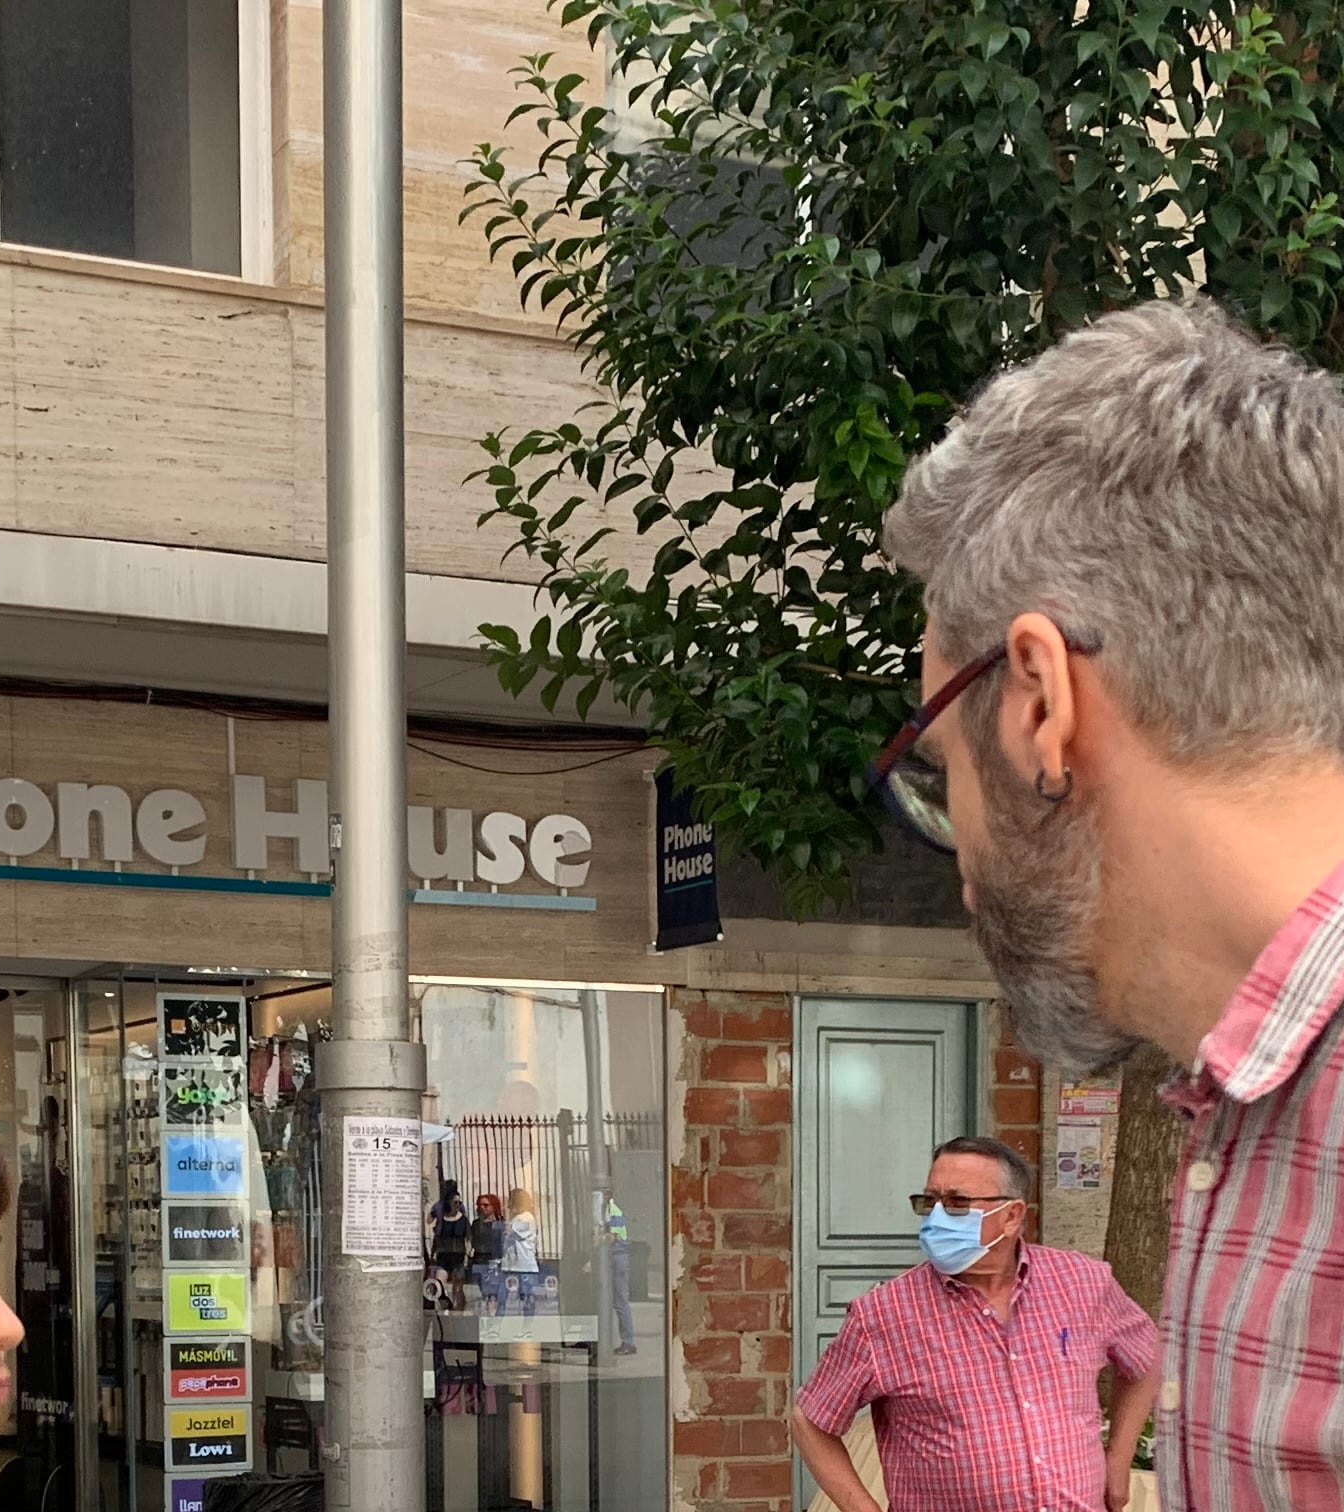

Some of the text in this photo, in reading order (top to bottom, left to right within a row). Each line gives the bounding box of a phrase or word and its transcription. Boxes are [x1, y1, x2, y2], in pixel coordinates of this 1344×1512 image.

[234, 774, 592, 888] Huse
[663, 822, 713, 853] Phone
[663, 852, 713, 885] House
[372, 1137, 391, 1150] 15
[176, 1156, 236, 1172] alterna
[172, 1226, 241, 1239] finetwork
[191, 1284, 210, 1296] luz
[192, 1297, 215, 1307] dos
[202, 1308, 226, 1320] tres
[186, 1416, 235, 1431] Jazztel
[189, 1441, 233, 1457] Lowi
